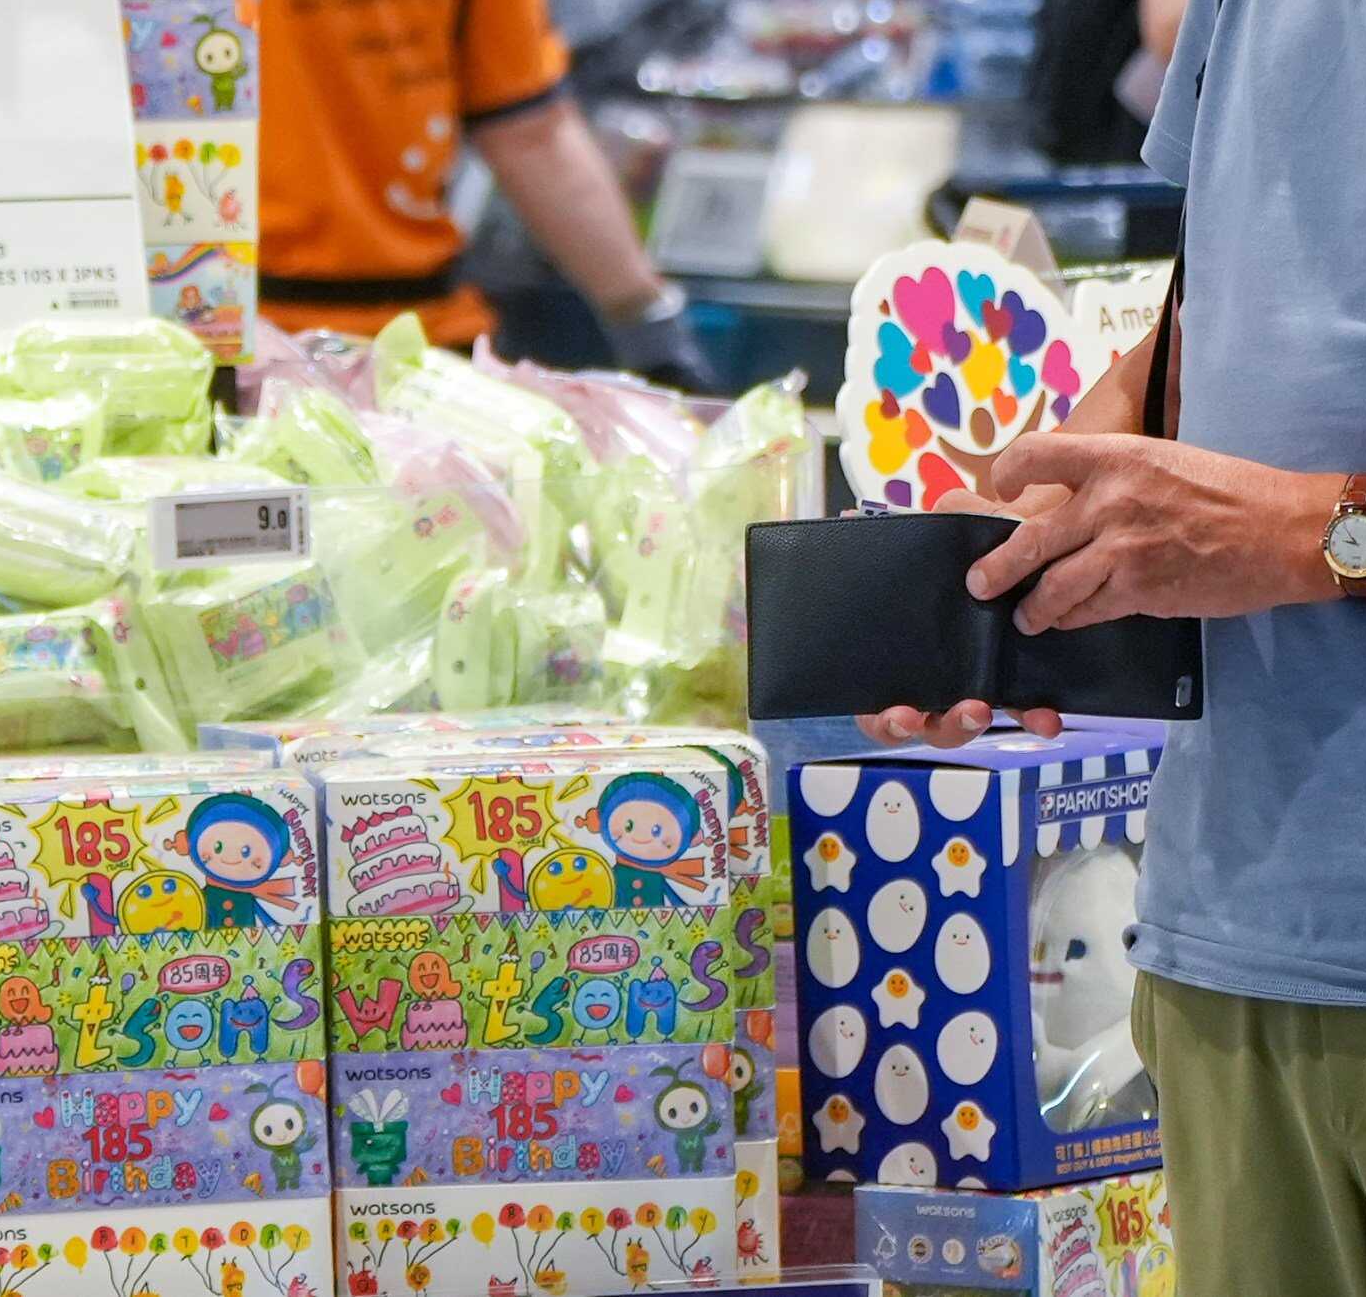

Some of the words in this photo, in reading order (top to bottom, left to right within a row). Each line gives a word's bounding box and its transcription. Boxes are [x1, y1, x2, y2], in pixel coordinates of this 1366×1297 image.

[1099, 306, 1116, 333] A
[1121, 306, 1164, 330] me
[258, 505, 287, 530] 9.0
[689, 770, 721, 795] HAPPY
[278, 788, 311, 816] HAPPY
[341, 791, 427, 807] watsons
[466, 790, 543, 843] 185
[54, 814, 131, 869] 185
[342, 929, 430, 946] watsons
[571, 944, 634, 965] 185周年
[162, 962, 227, 985] 185周年
[344, 1064, 432, 1083] watsons
[466, 1063, 611, 1108] Happy
[59, 1087, 203, 1129] Happy
[488, 1103, 559, 1141] 185
[81, 1123, 154, 1163] 185
[452, 1136, 626, 1177] Birthday
[47, 1156, 222, 1199] Birthday
[349, 1201, 437, 1217] watsons
[503, 1207, 717, 1231] BIRTHDAY
[915, 1204, 977, 1219] watsons
[1106, 1195, 1144, 1246] 185
[95, 1225, 307, 1251] BIRTHDAY
